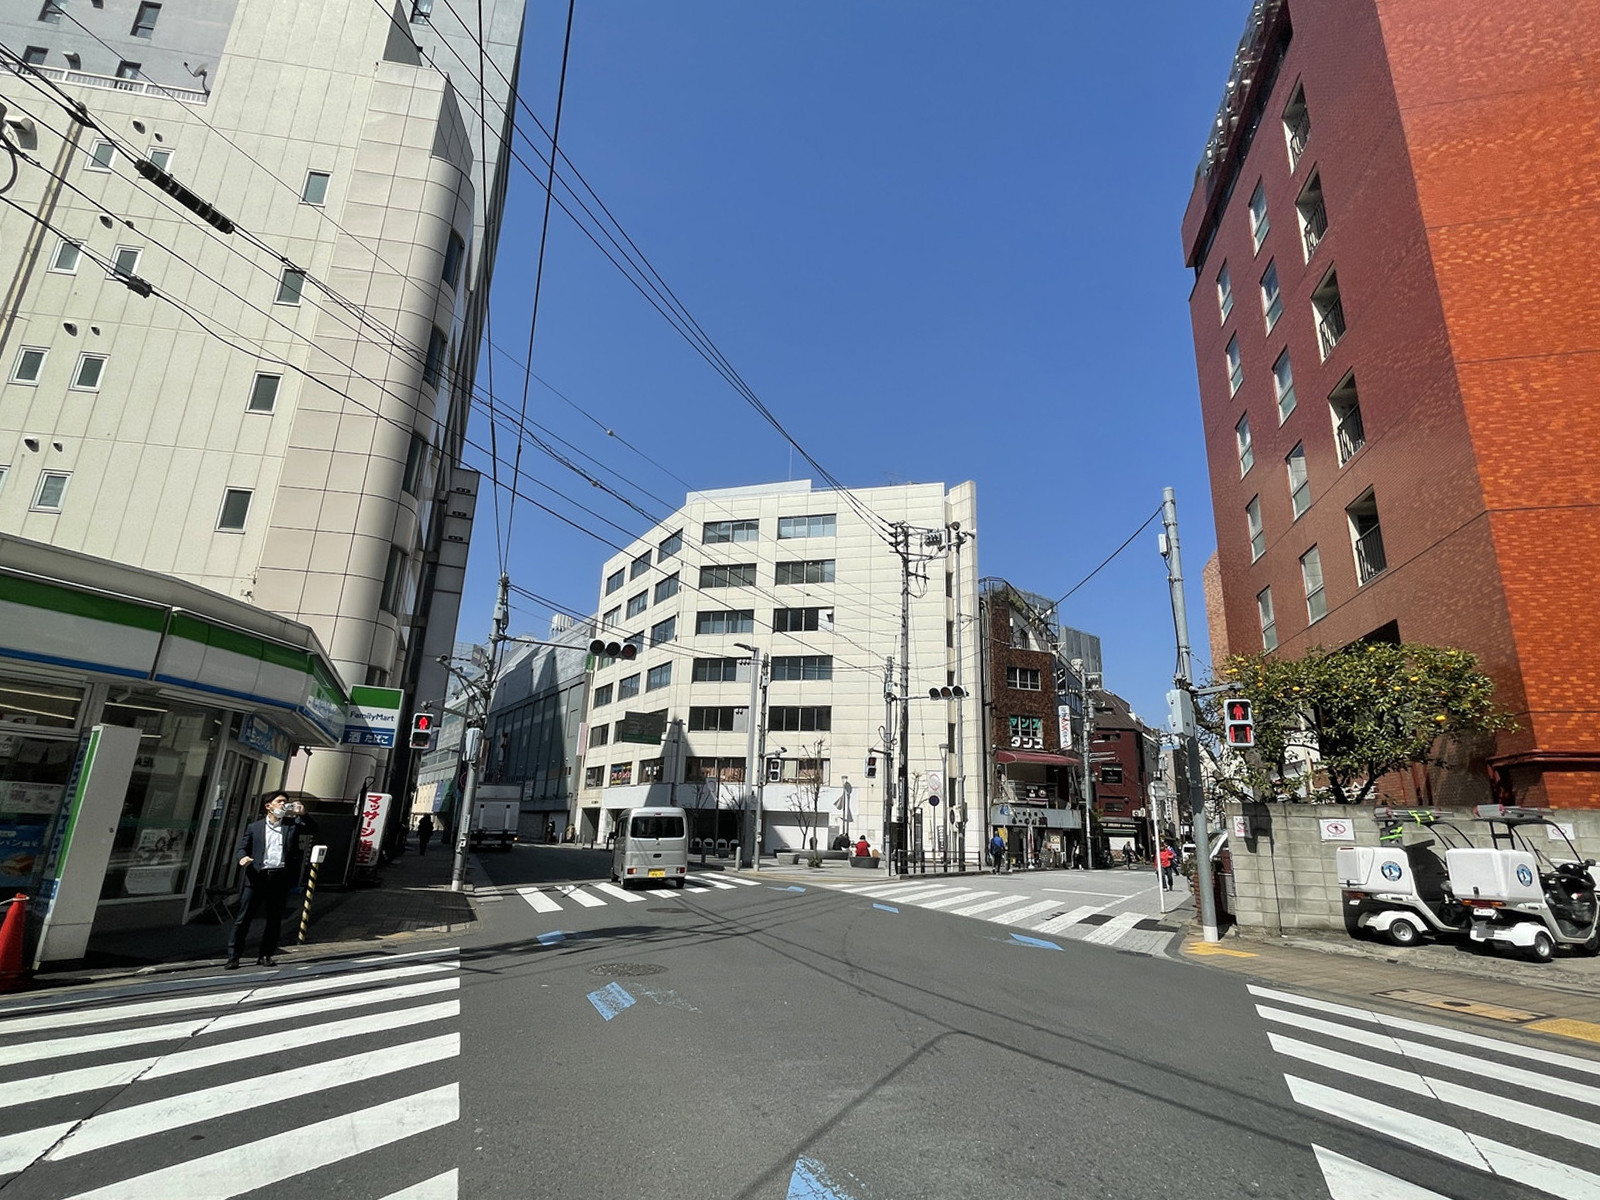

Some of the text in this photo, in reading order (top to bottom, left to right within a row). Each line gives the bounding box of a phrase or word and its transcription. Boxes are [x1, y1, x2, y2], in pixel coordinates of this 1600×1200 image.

[350, 711, 395, 721] FamilyMart
[348, 731, 389, 744] 酒 たばこ
